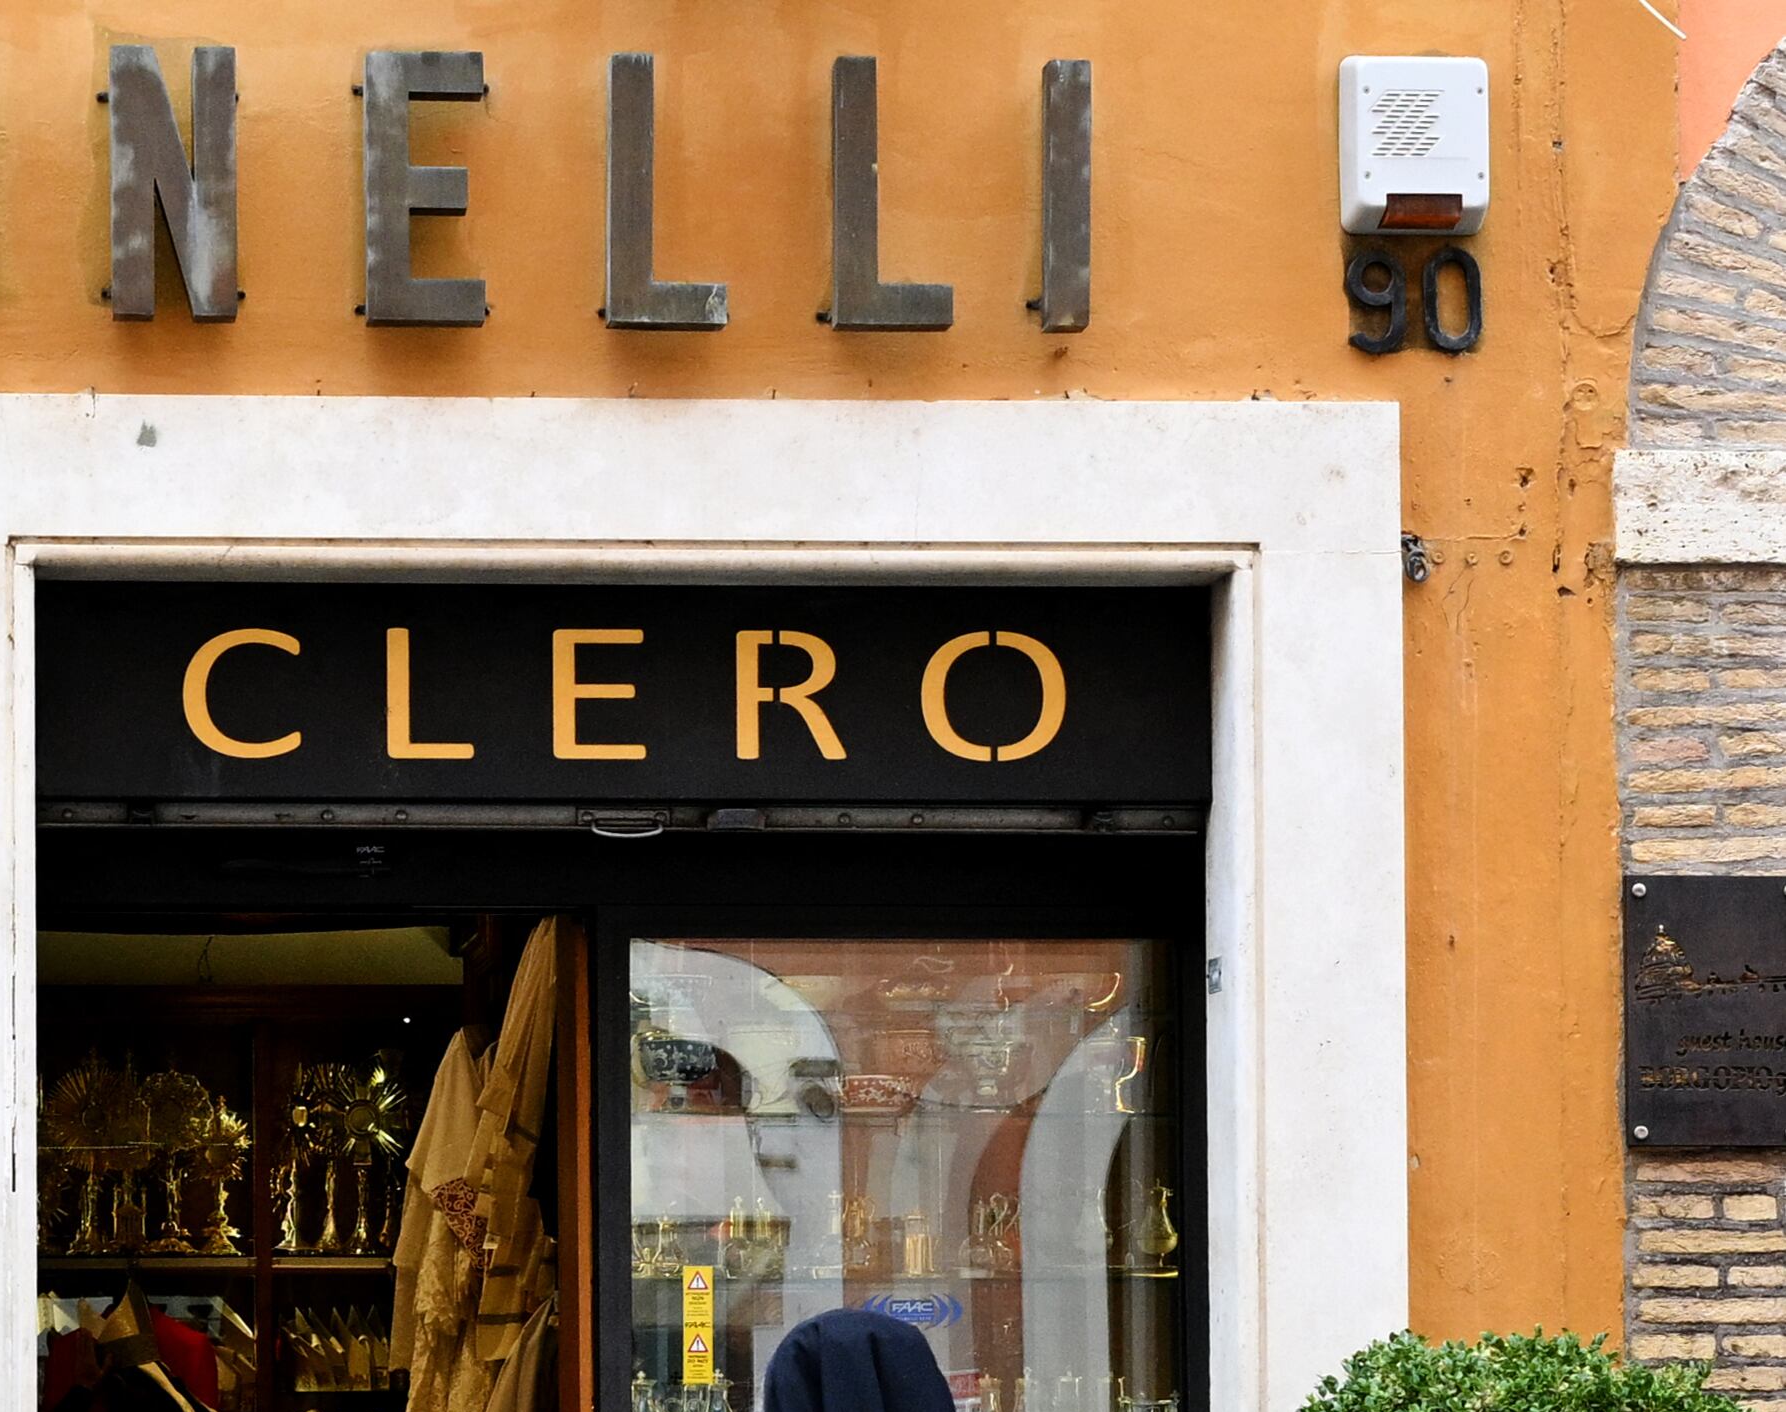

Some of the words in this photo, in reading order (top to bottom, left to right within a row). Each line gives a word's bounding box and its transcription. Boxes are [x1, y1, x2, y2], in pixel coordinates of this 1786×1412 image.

[1345, 246, 1483, 354] 90
[182, 627, 1067, 762] CLERO
[1675, 1031, 1733, 1057] guest
[1736, 1028, 1786, 1052] hous
[892, 1301, 933, 1313] FAAC
